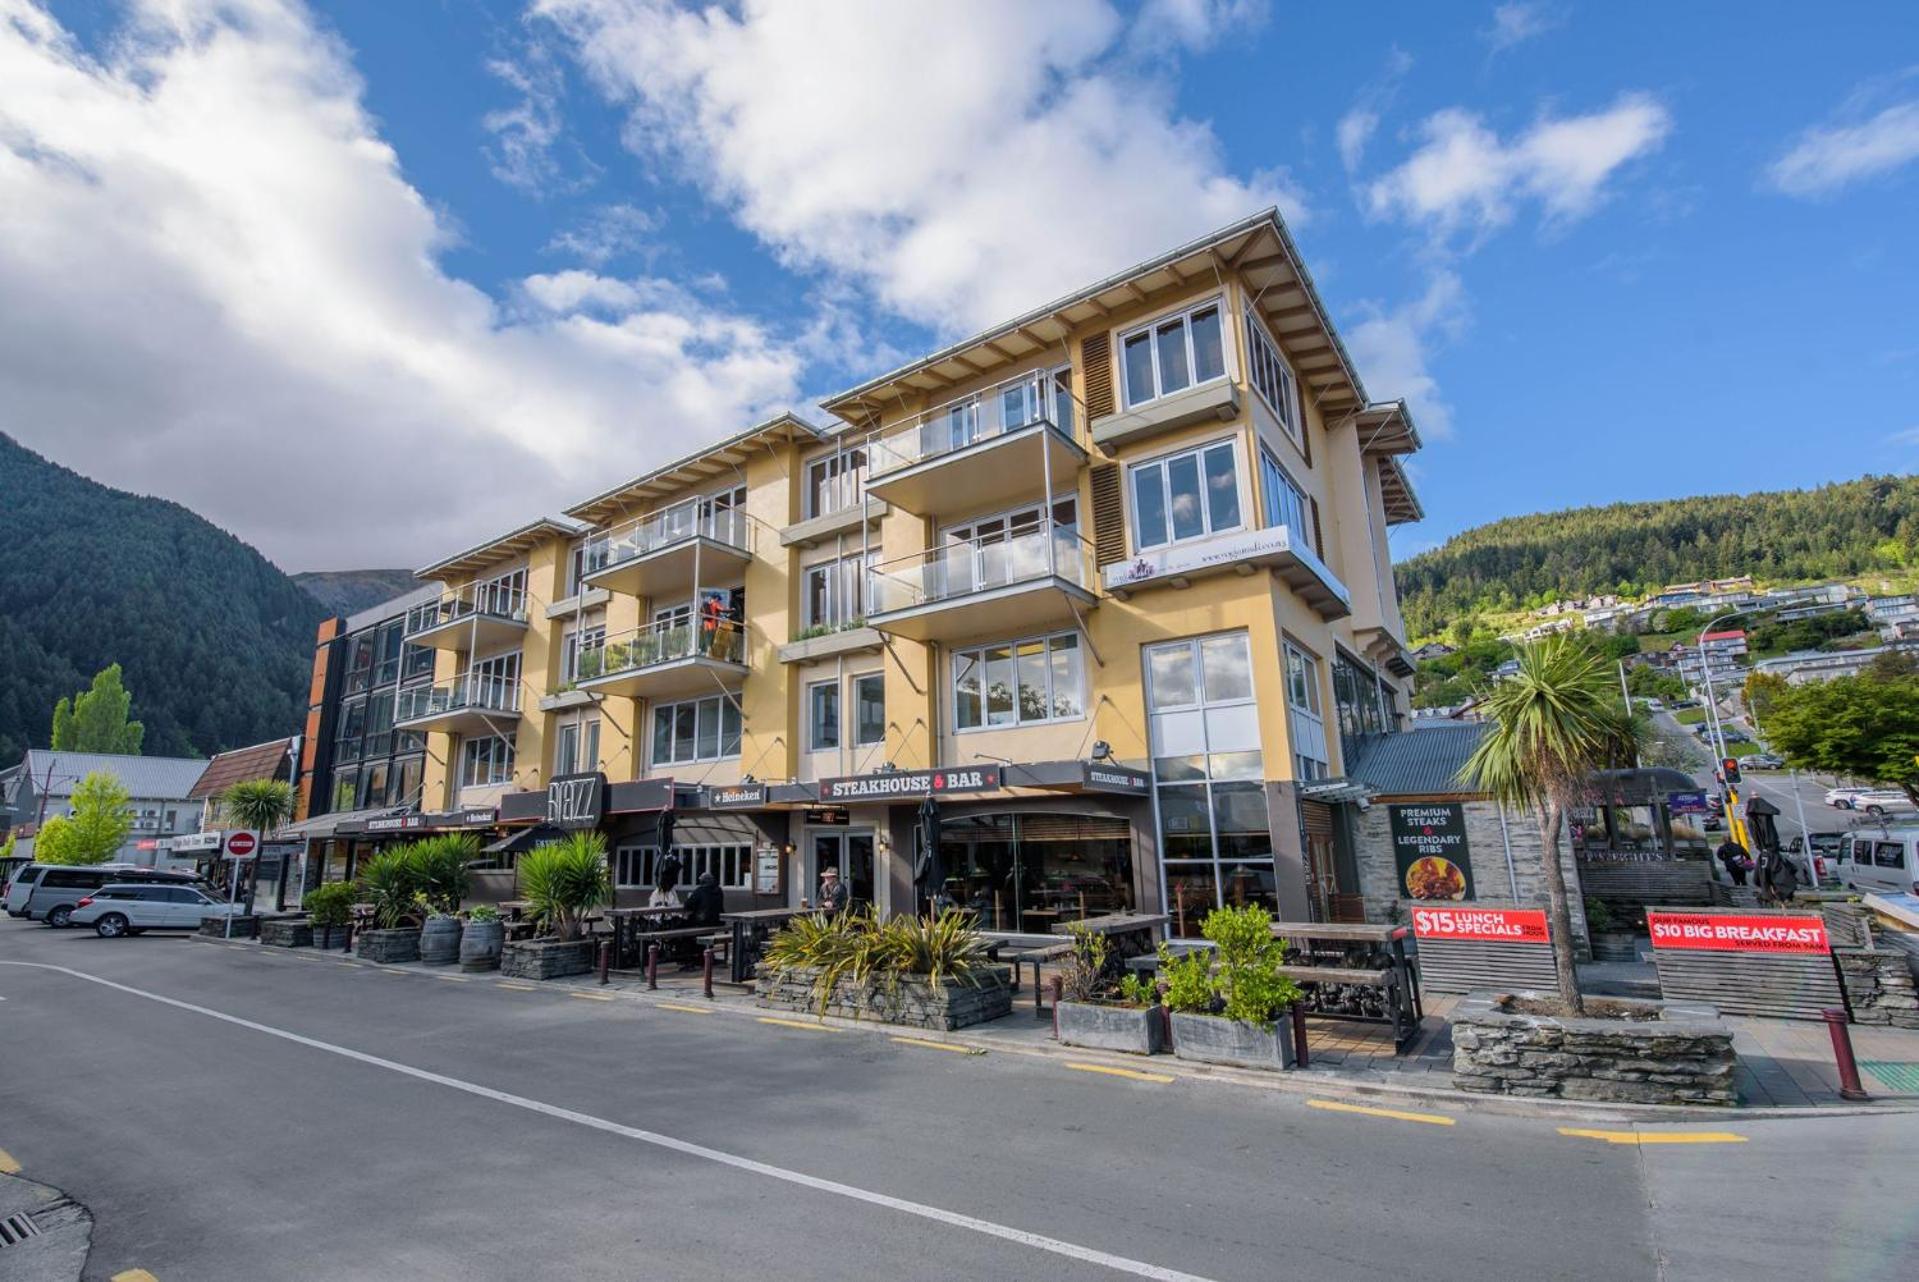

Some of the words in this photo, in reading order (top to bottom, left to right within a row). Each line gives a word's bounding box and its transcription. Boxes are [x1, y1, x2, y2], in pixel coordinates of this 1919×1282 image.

[832, 775, 931, 797] STEAKHOUSE
[933, 774, 944, 790] &
[947, 771, 984, 788] BAR
[1090, 771, 1129, 785] STEAKHOUSE
[722, 789, 760, 803] Heineken
[1400, 808, 1451, 817] PREMIUM
[1407, 817, 1447, 826] STEAKS
[1397, 835, 1461, 845] LEGENDARY
[1419, 845, 1443, 854] RIBS
[1415, 911, 1455, 935] $15
[1455, 912, 1504, 924] LUNCH
[1456, 923, 1522, 936] SPECIALS
[1653, 924, 1681, 938] $10
[1684, 925, 1713, 939] BIG
[1716, 926, 1820, 942] BREAKFAST
[1735, 939, 1771, 947] SERVED
